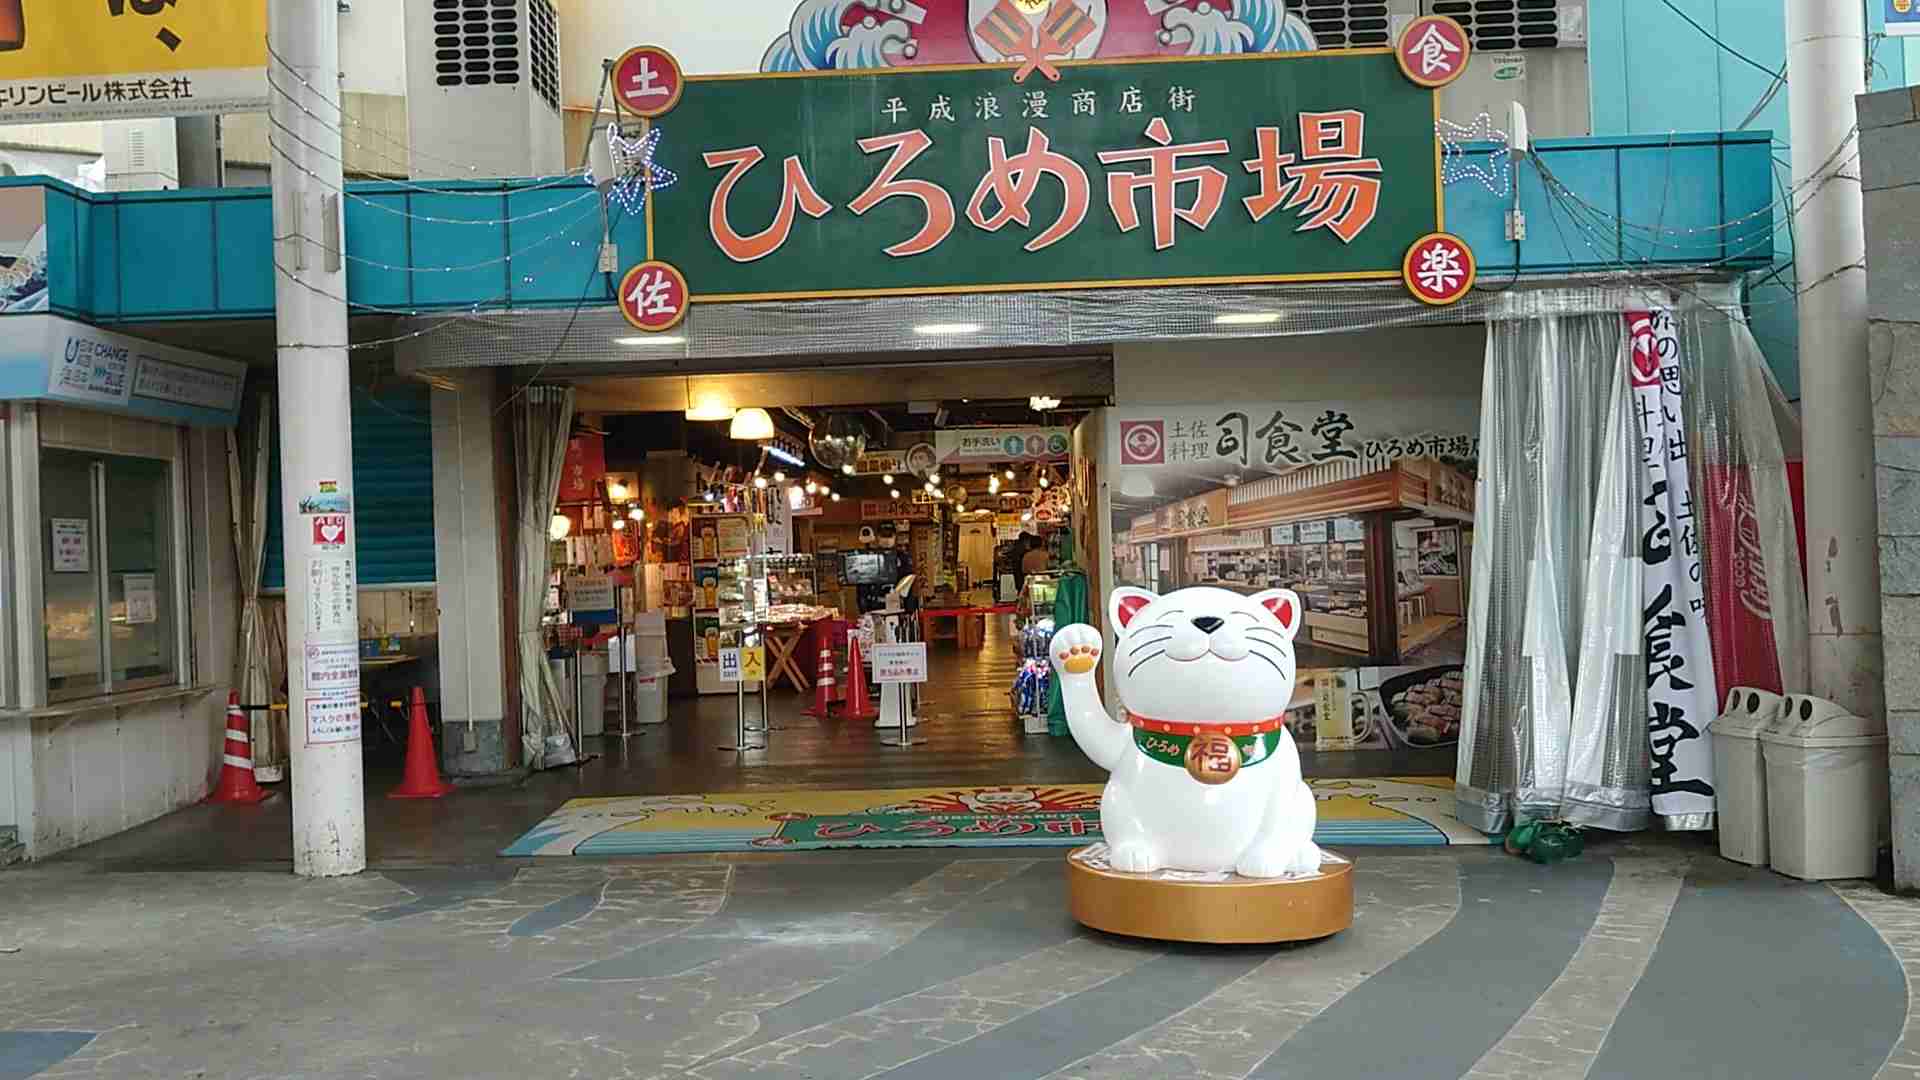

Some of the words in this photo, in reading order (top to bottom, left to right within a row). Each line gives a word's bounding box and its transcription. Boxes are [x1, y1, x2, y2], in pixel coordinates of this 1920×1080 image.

[1408, 23, 1460, 75] 食
[625, 58, 669, 98] 土
[882, 85, 1195, 123] 平成浪漫商店街
[703, 109, 1383, 262] ひろめ市場
[1417, 243, 1464, 293] 楽
[626, 273, 678, 317] 佐
[962, 436, 1000, 448] お手洗い
[1168, 420, 1209, 441] 土佐
[1216, 410, 1358, 465] 司食堂
[315, 516, 344, 526] AED
[723, 653, 737, 667] 出
[744, 652, 761, 668] 入
[1146, 737, 1180, 756] ひろめ
[1191, 737, 1232, 772] 福
